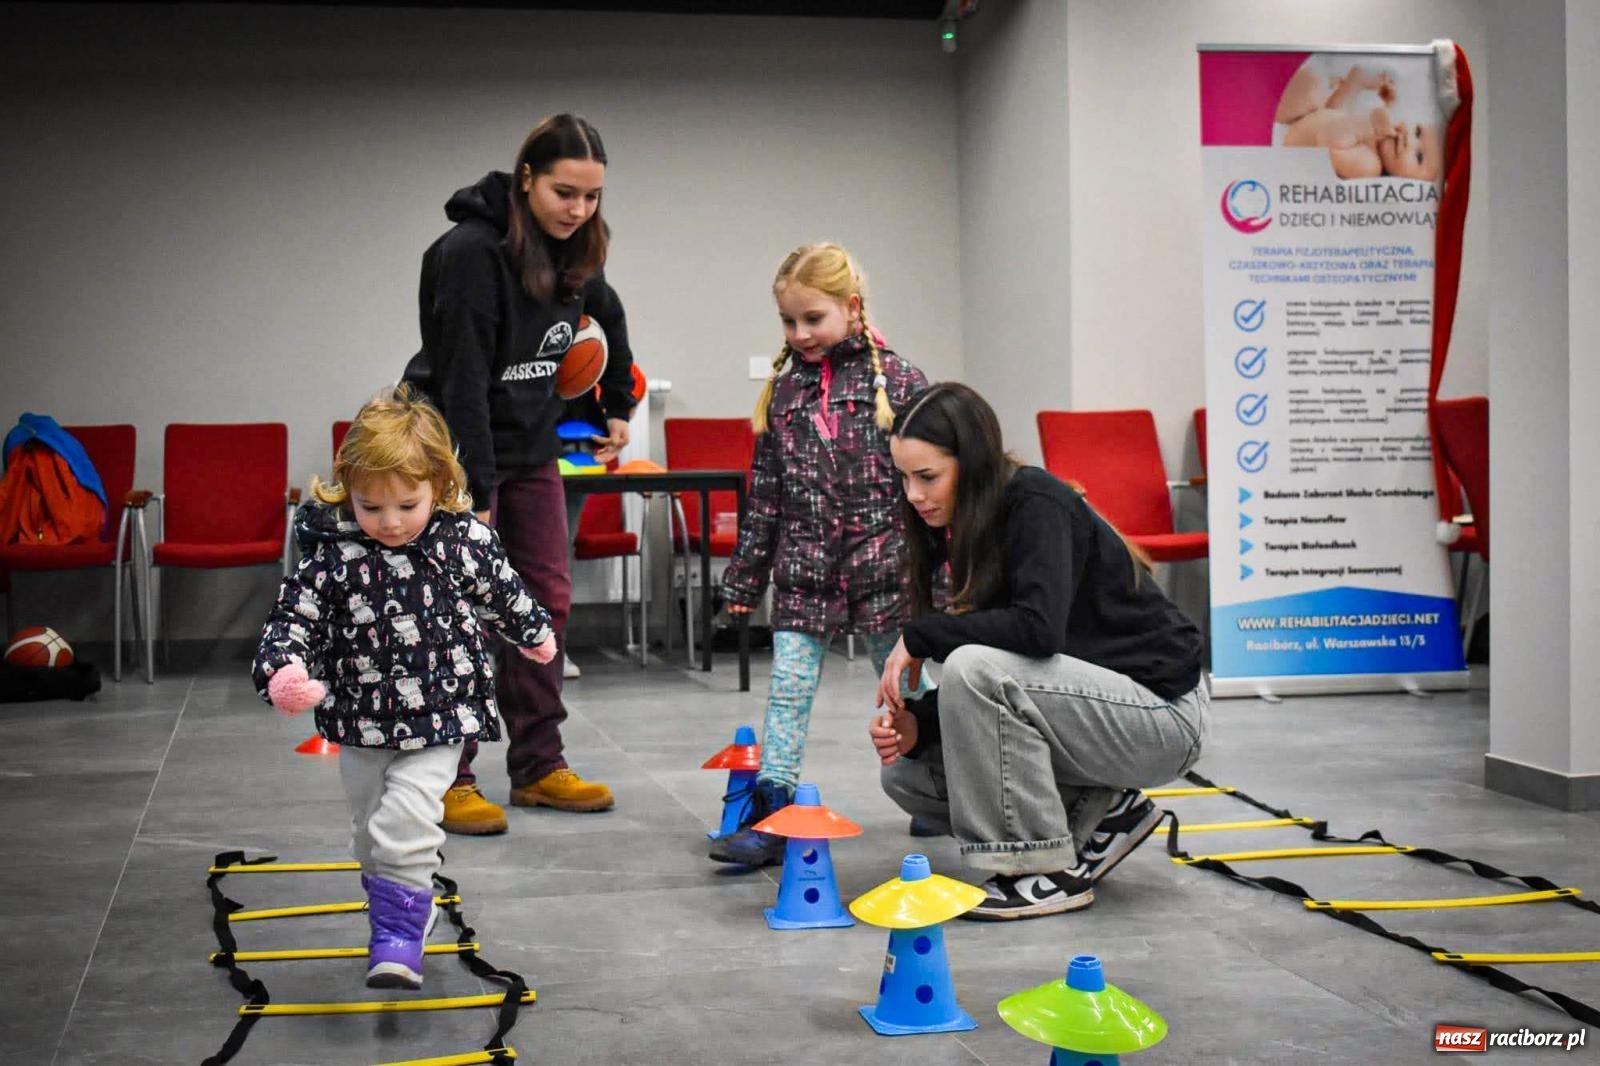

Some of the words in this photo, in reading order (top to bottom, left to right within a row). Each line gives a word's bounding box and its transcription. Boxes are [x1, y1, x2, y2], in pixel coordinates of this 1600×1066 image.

[1280, 183, 1438, 203] REHABILITACJA
[1280, 211, 1325, 228] DZIECI
[1331, 211, 1335, 227] I
[1264, 491, 1300, 499] Badanie
[1375, 488, 1434, 499] Centralnego
[1264, 517, 1298, 526] Terapia
[1265, 543, 1298, 552] Terapia
[1266, 568, 1299, 578] Terapia
[1323, 636, 1396, 648] Warszawska
